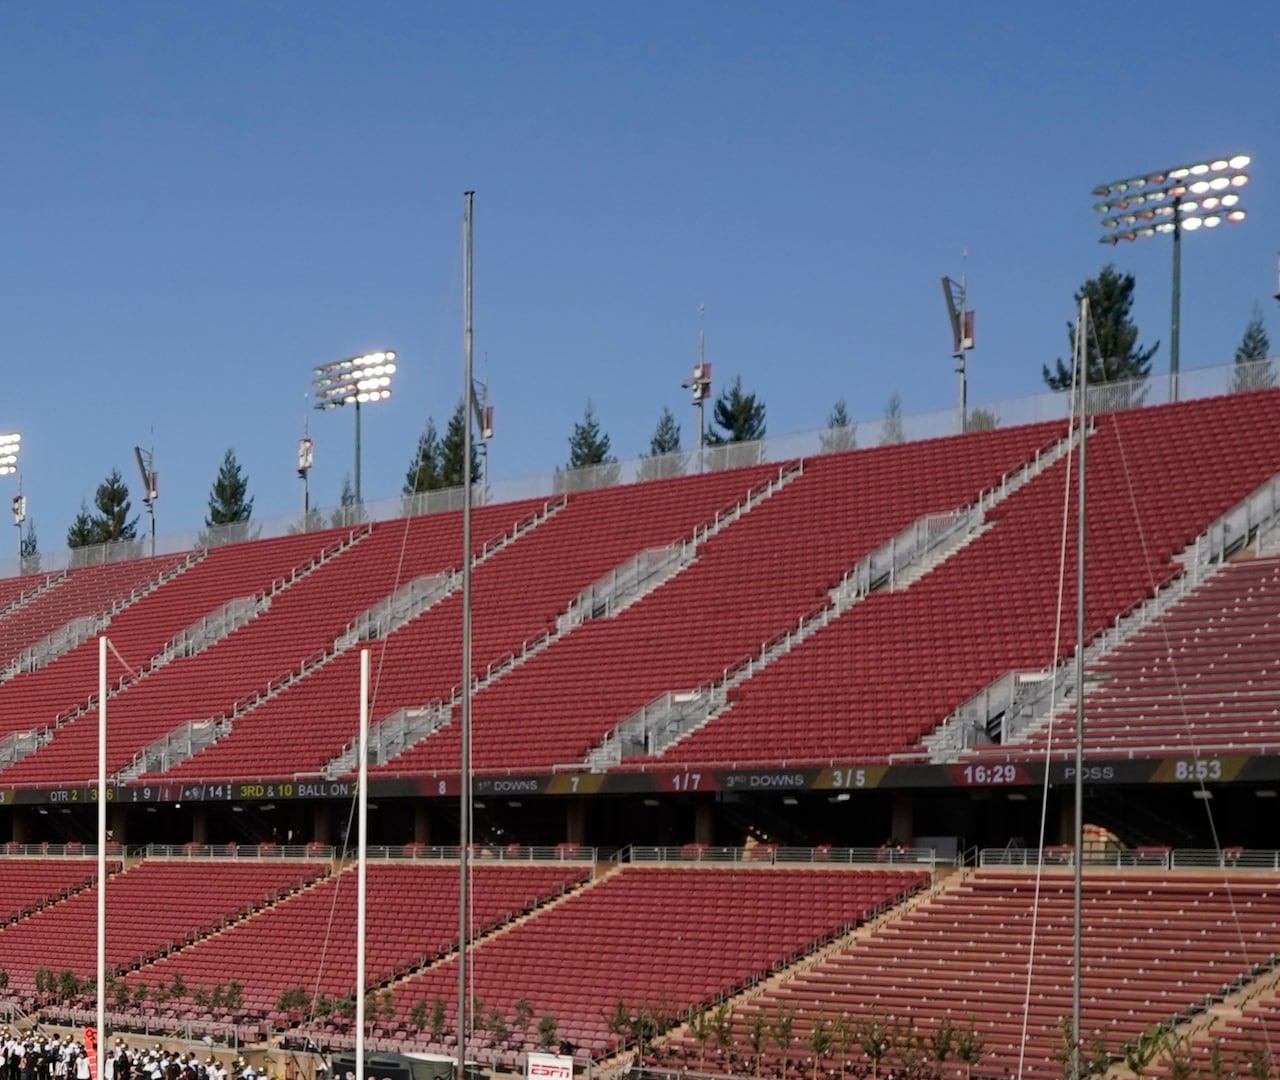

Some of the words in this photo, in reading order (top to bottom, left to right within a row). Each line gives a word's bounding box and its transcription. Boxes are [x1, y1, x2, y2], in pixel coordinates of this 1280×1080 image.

[963, 765, 1016, 784] 16:29
[1064, 766, 1114, 780] POSS
[1175, 760, 1222, 780] 8:53
[494, 780, 538, 791] DOWNS
[571, 777, 579, 792] 7
[750, 774, 804, 787] DOWNS
[143, 788, 150, 799] 9
[209, 786, 223, 798] 14
[241, 785, 264, 797] 3RD
[267, 786, 275, 796] &
[278, 784, 292, 796] 10
[298, 784, 327, 796] BALL
[330, 783, 348, 795] ON
[438, 781, 446, 794] 8
[50, 792, 68, 801] QTR
[71, 791, 78, 801] 2
[530, 1064, 571, 1080] ESPN
